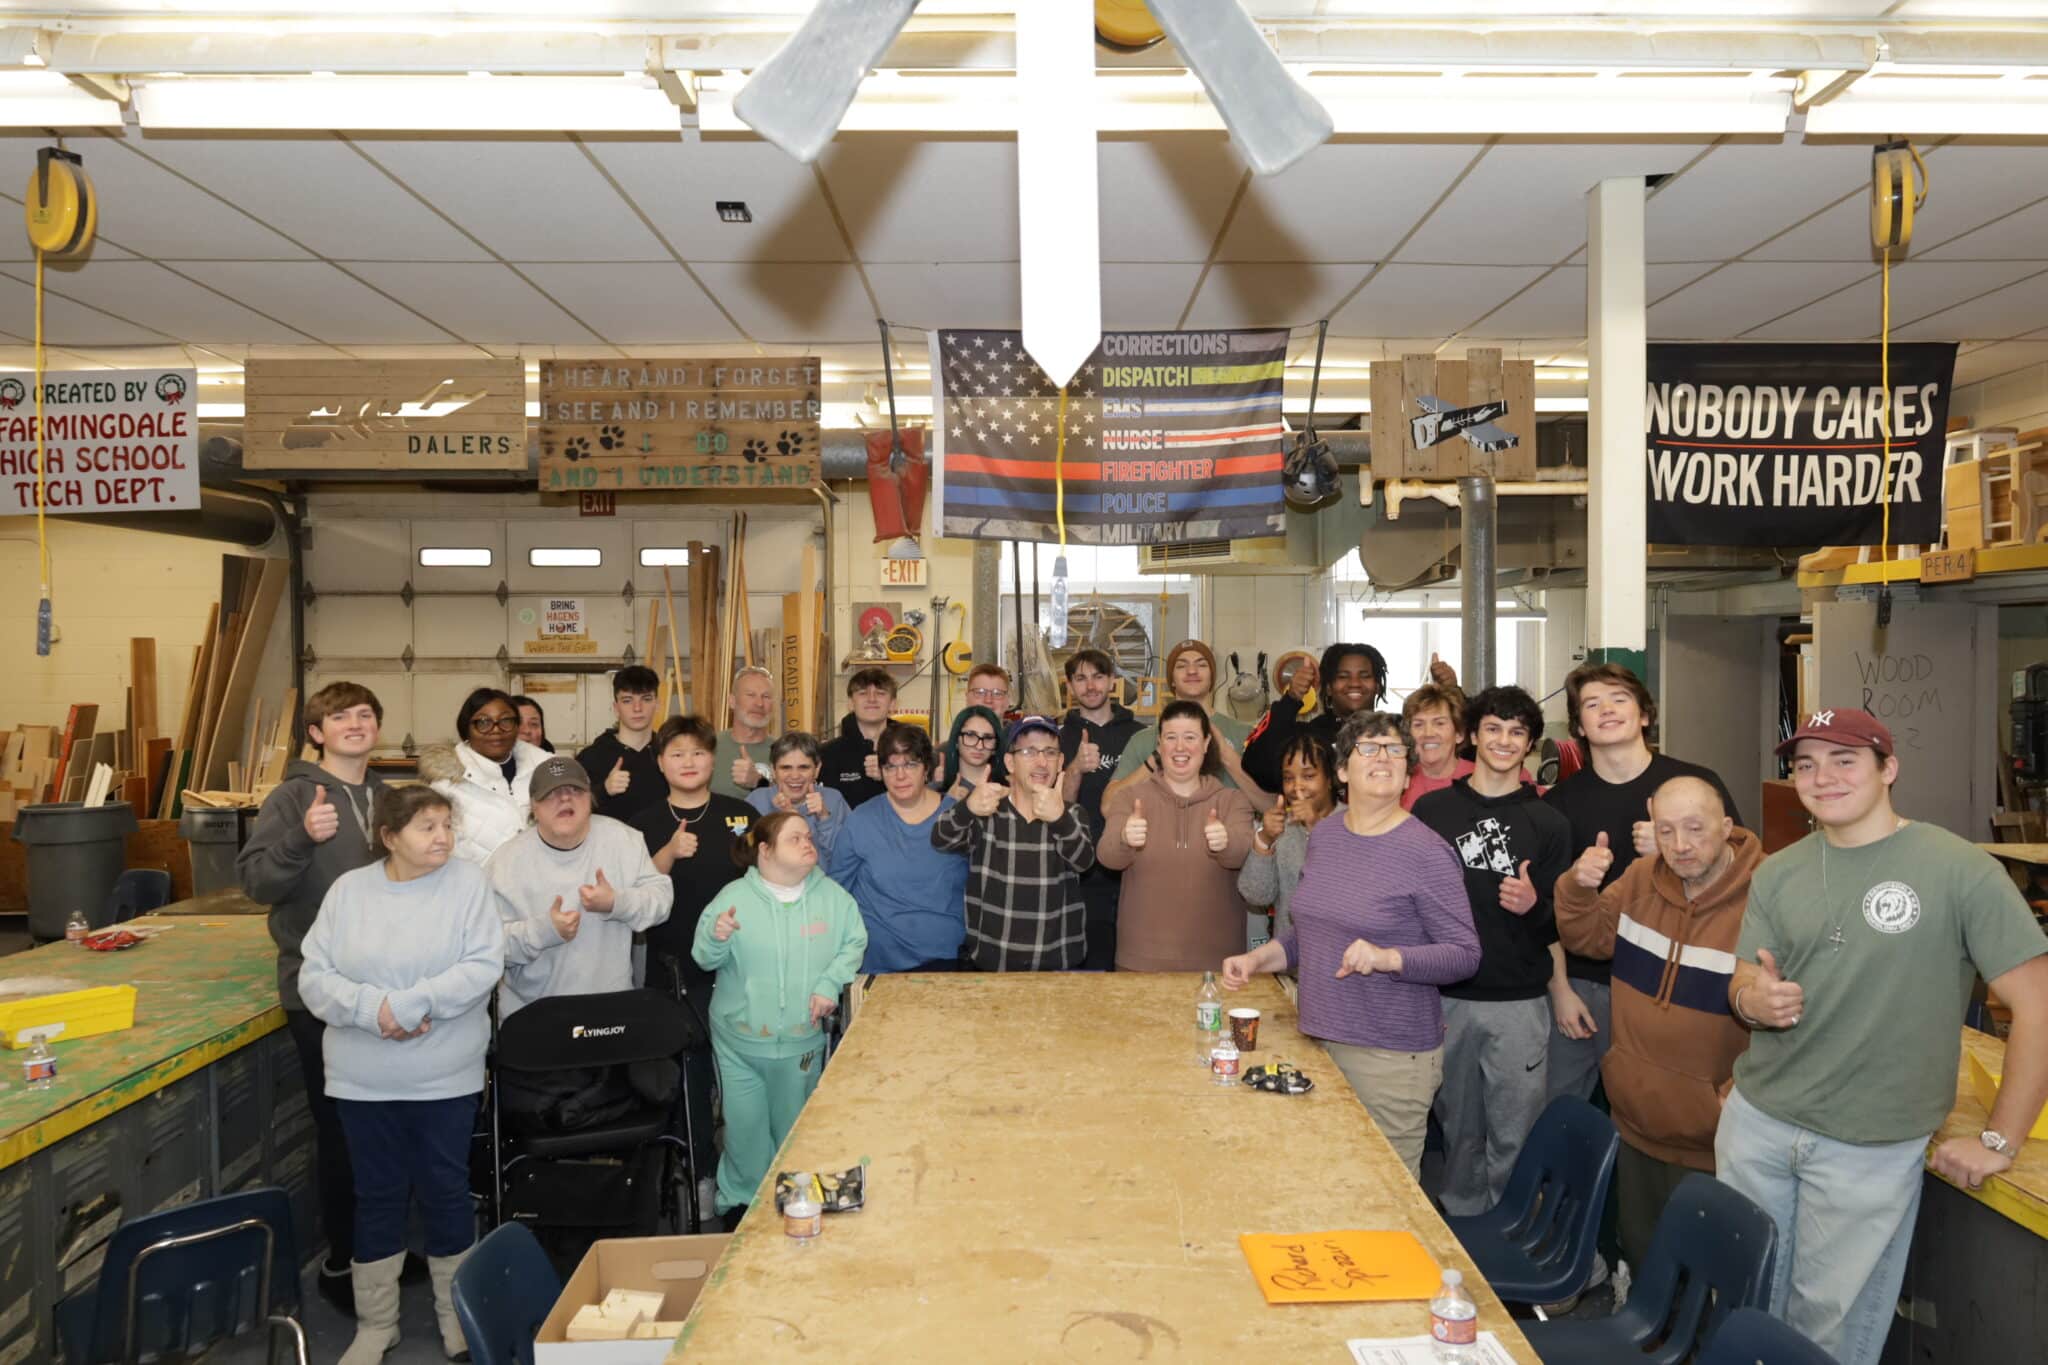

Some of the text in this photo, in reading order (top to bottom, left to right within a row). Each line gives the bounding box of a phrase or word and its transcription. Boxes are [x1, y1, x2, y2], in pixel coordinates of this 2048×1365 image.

[1102, 334, 1228, 356] CORRECTIONS
[563, 367, 631, 387] HEAR
[639, 367, 687, 387] AND
[697, 366, 704, 386] I
[714, 366, 817, 387] FORGET
[1102, 366, 1189, 388] DISPATCH
[124, 381, 148, 402] BY
[558, 402, 603, 421] SEE
[611, 401, 659, 420] AND
[668, 400, 676, 420] I
[686, 400, 820, 420] REMEMBER
[1102, 398, 1143, 418] EMS
[1645, 382, 1939, 441] NOBODY CARES
[408, 435, 510, 454] DALERS
[696, 432, 728, 453] DO
[1102, 429, 1164, 450] NURSE
[76, 444, 186, 473] SCHOOL
[1102, 458, 1213, 481] FIREFIGHTER
[549, 466, 598, 488] AND
[638, 465, 811, 487] UNDERSTAND
[1647, 449, 1923, 507] WORK HARDER
[95, 477, 176, 505] DEPT.
[583, 491, 612, 513] EXIT
[1102, 493, 1166, 513] POLICE
[1102, 521, 1185, 544] MILITARY
[889, 560, 920, 583] EXIT
[550, 600, 576, 610] BRING
[785, 634, 799, 708] DECADES
[1855, 651, 1934, 685] WOOD
[1862, 687, 1943, 718] ROOM
